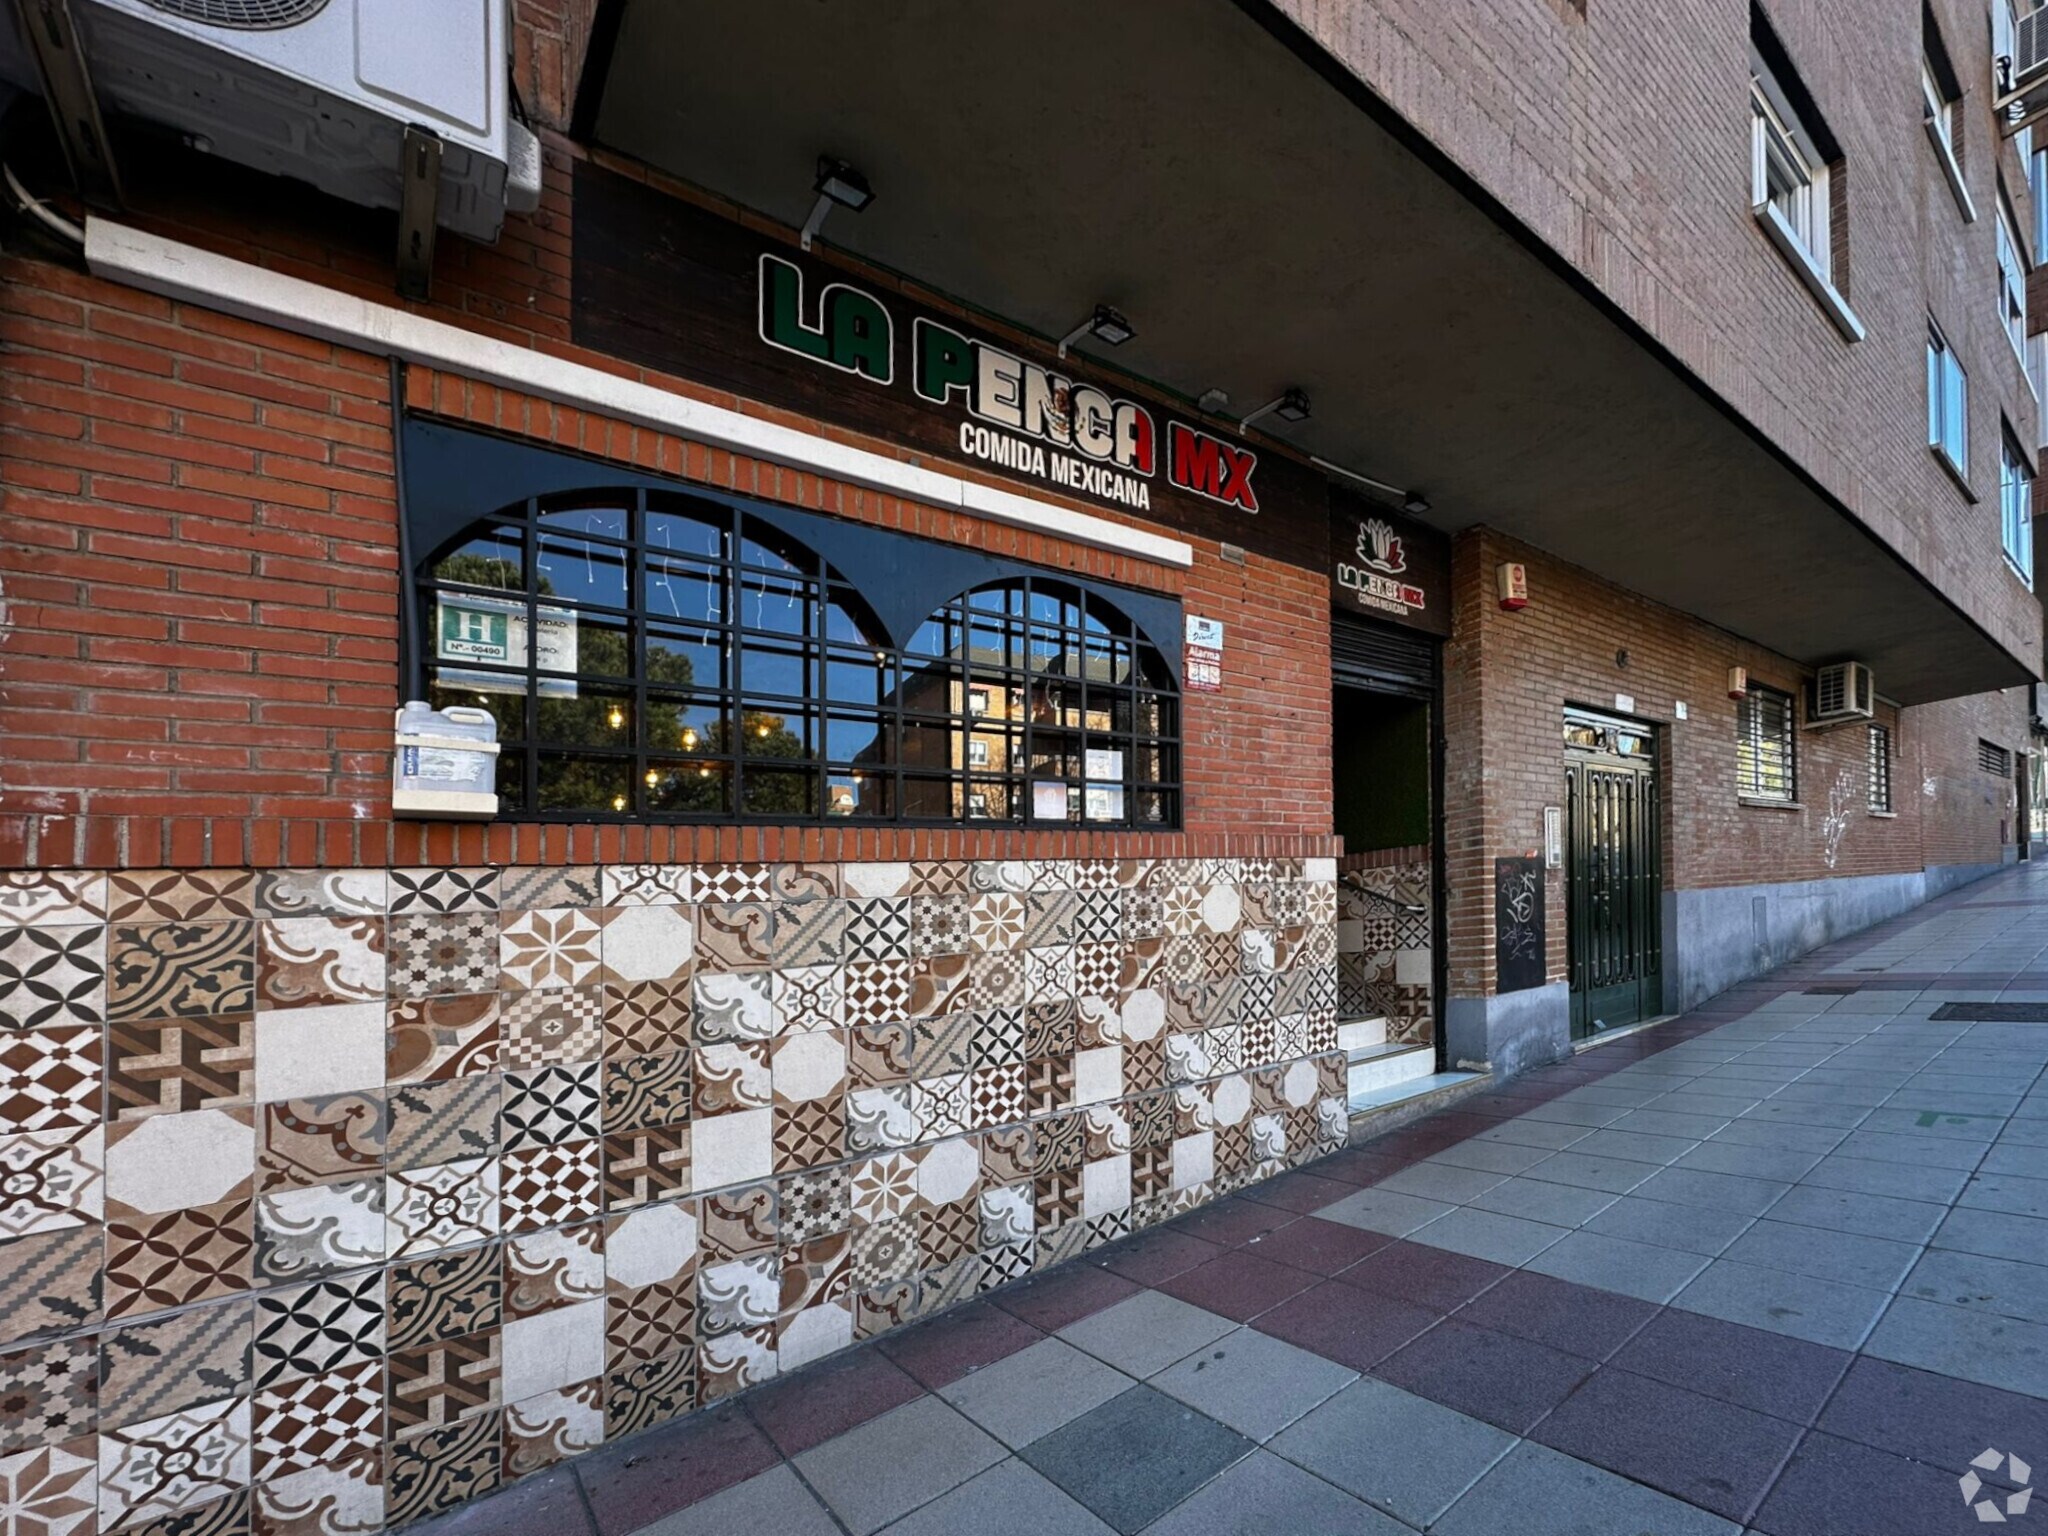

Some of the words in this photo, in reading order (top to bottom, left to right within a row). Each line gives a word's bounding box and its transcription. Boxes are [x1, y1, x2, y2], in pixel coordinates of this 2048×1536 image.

[759, 253, 893, 386] LA
[913, 317, 1156, 477] PENCA
[1167, 420, 1259, 514] MX
[960, 422, 1046, 478] COMIDA
[1051, 452, 1150, 511] MEXICANA
[455, 611, 496, 643] H
